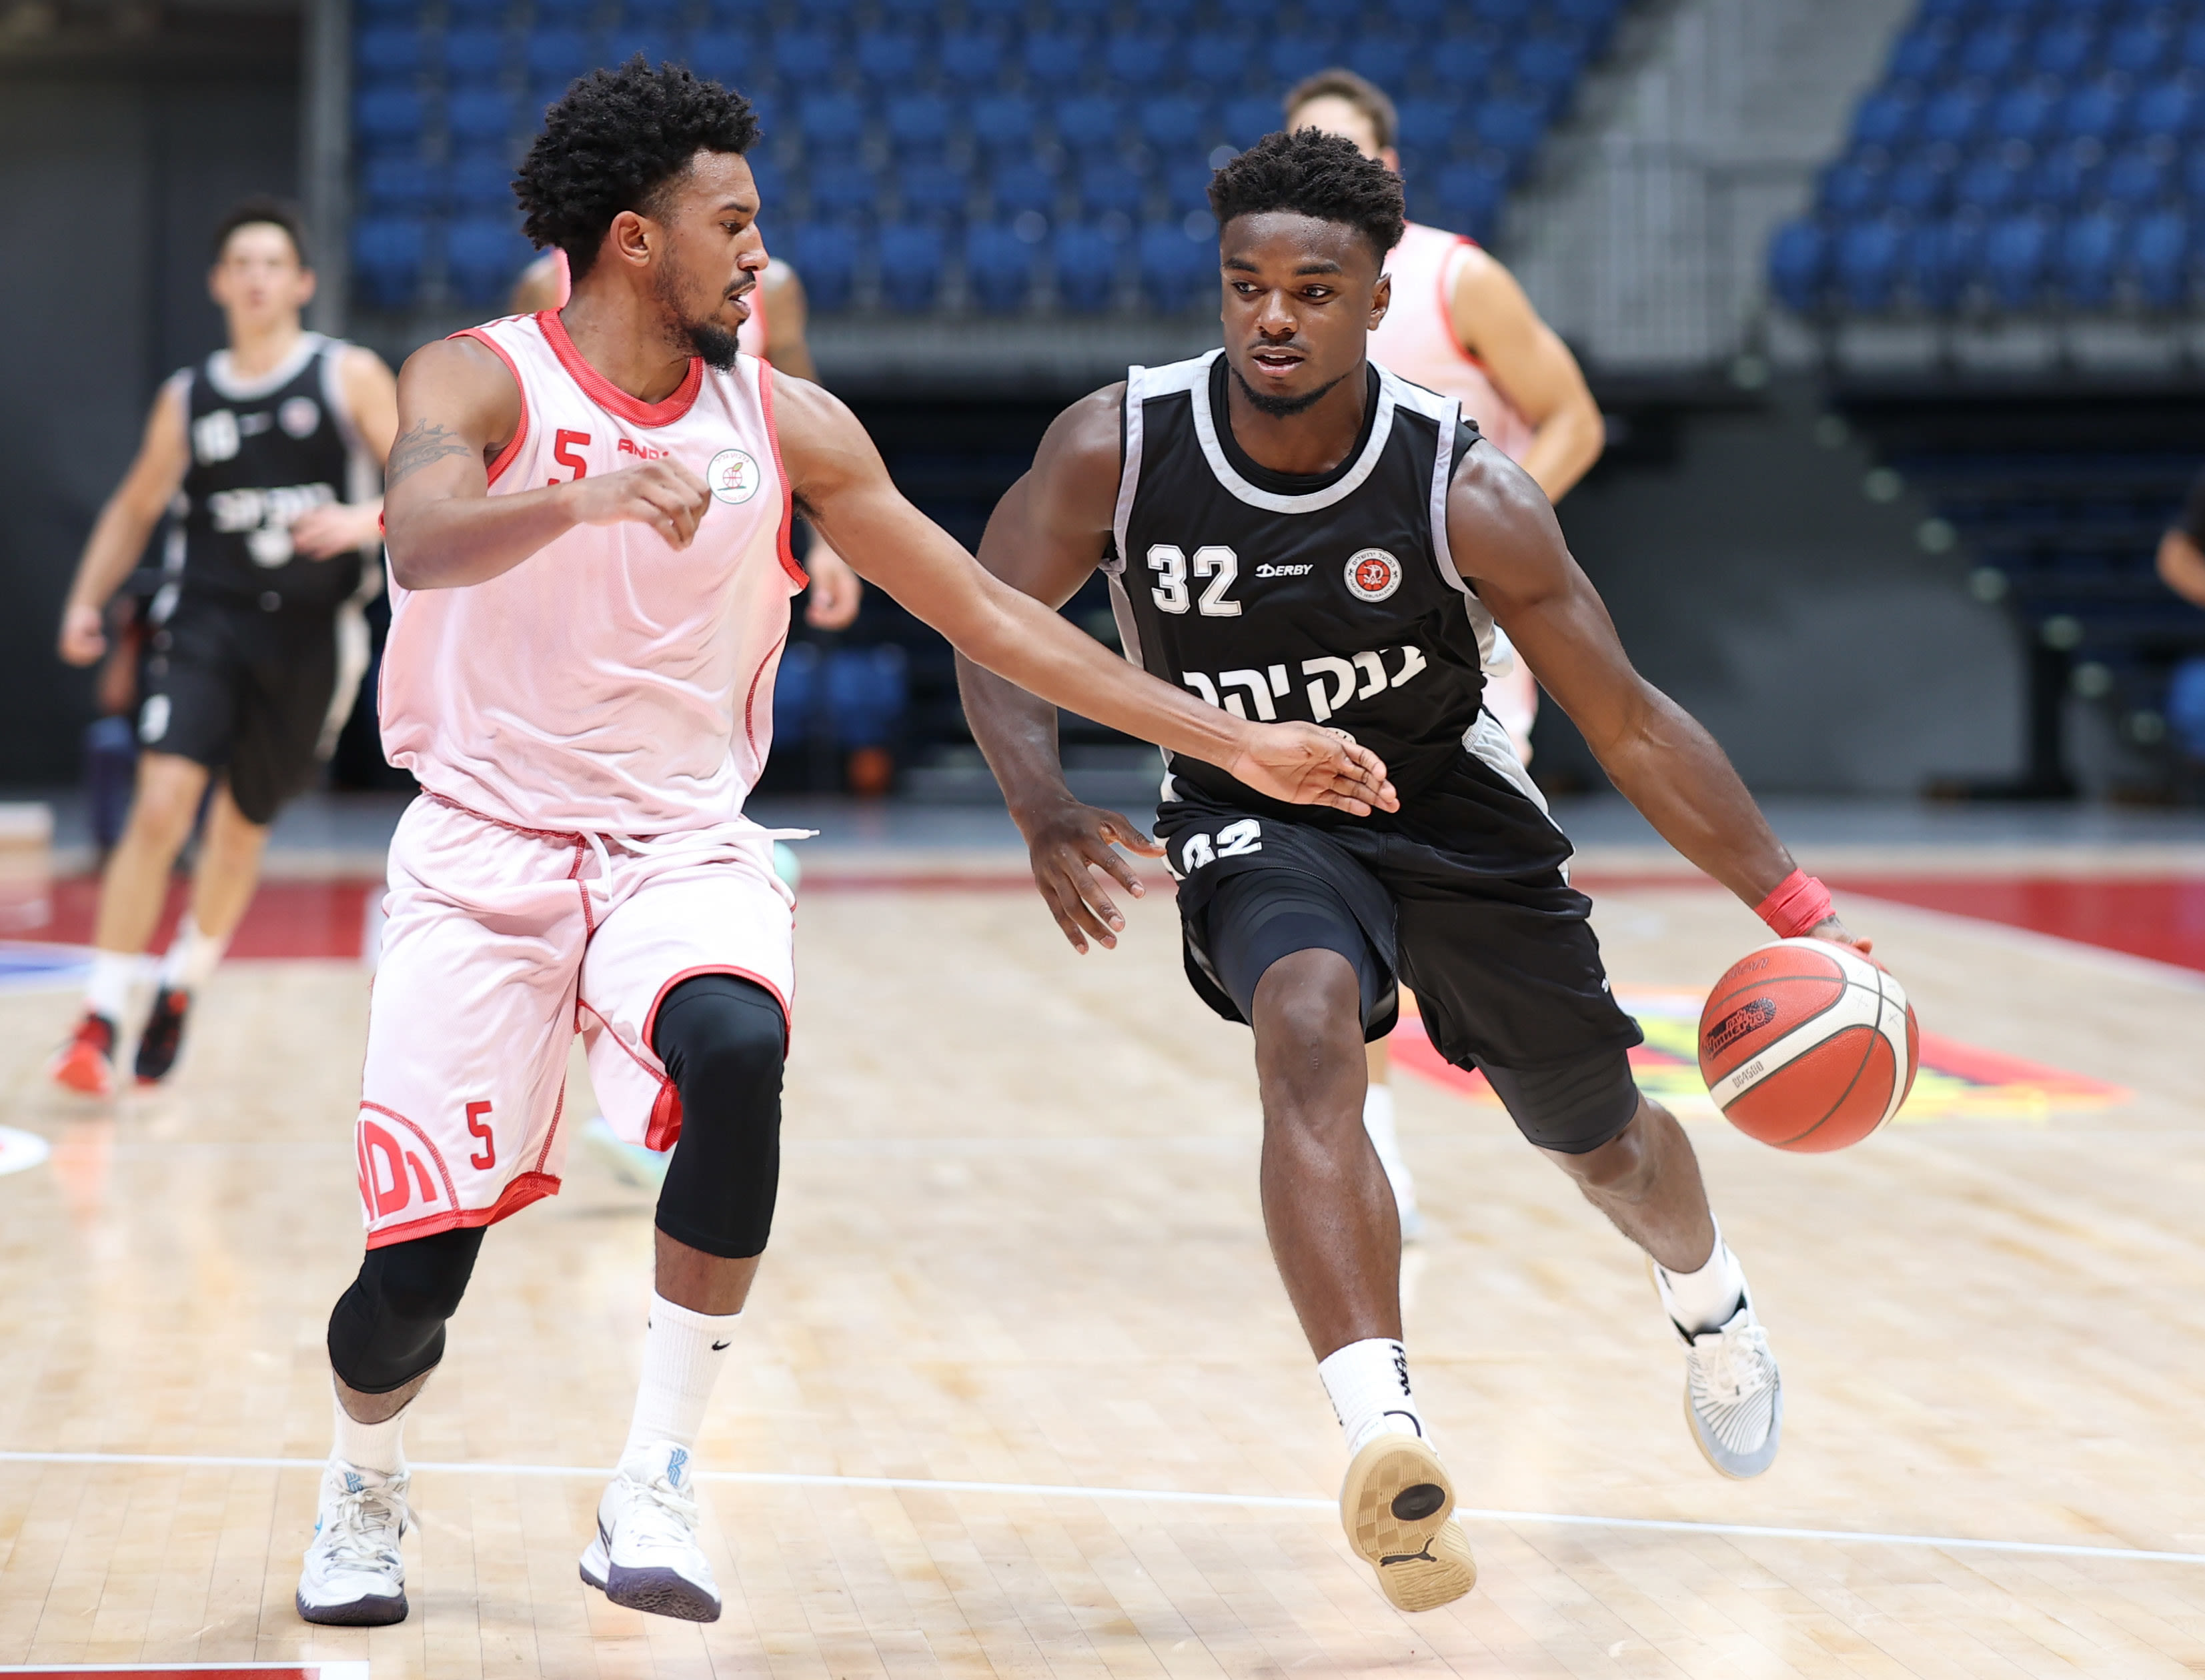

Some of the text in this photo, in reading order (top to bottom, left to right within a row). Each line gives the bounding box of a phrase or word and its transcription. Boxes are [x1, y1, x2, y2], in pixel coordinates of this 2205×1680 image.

[548, 429, 591, 487] 5
[618, 438, 669, 460] AND
[1255, 564, 1314, 578] DERBY
[1351, 552, 1396, 568] הפועל ירושלים
[1147, 544, 1243, 617] 32
[466, 1100, 496, 1170] 5
